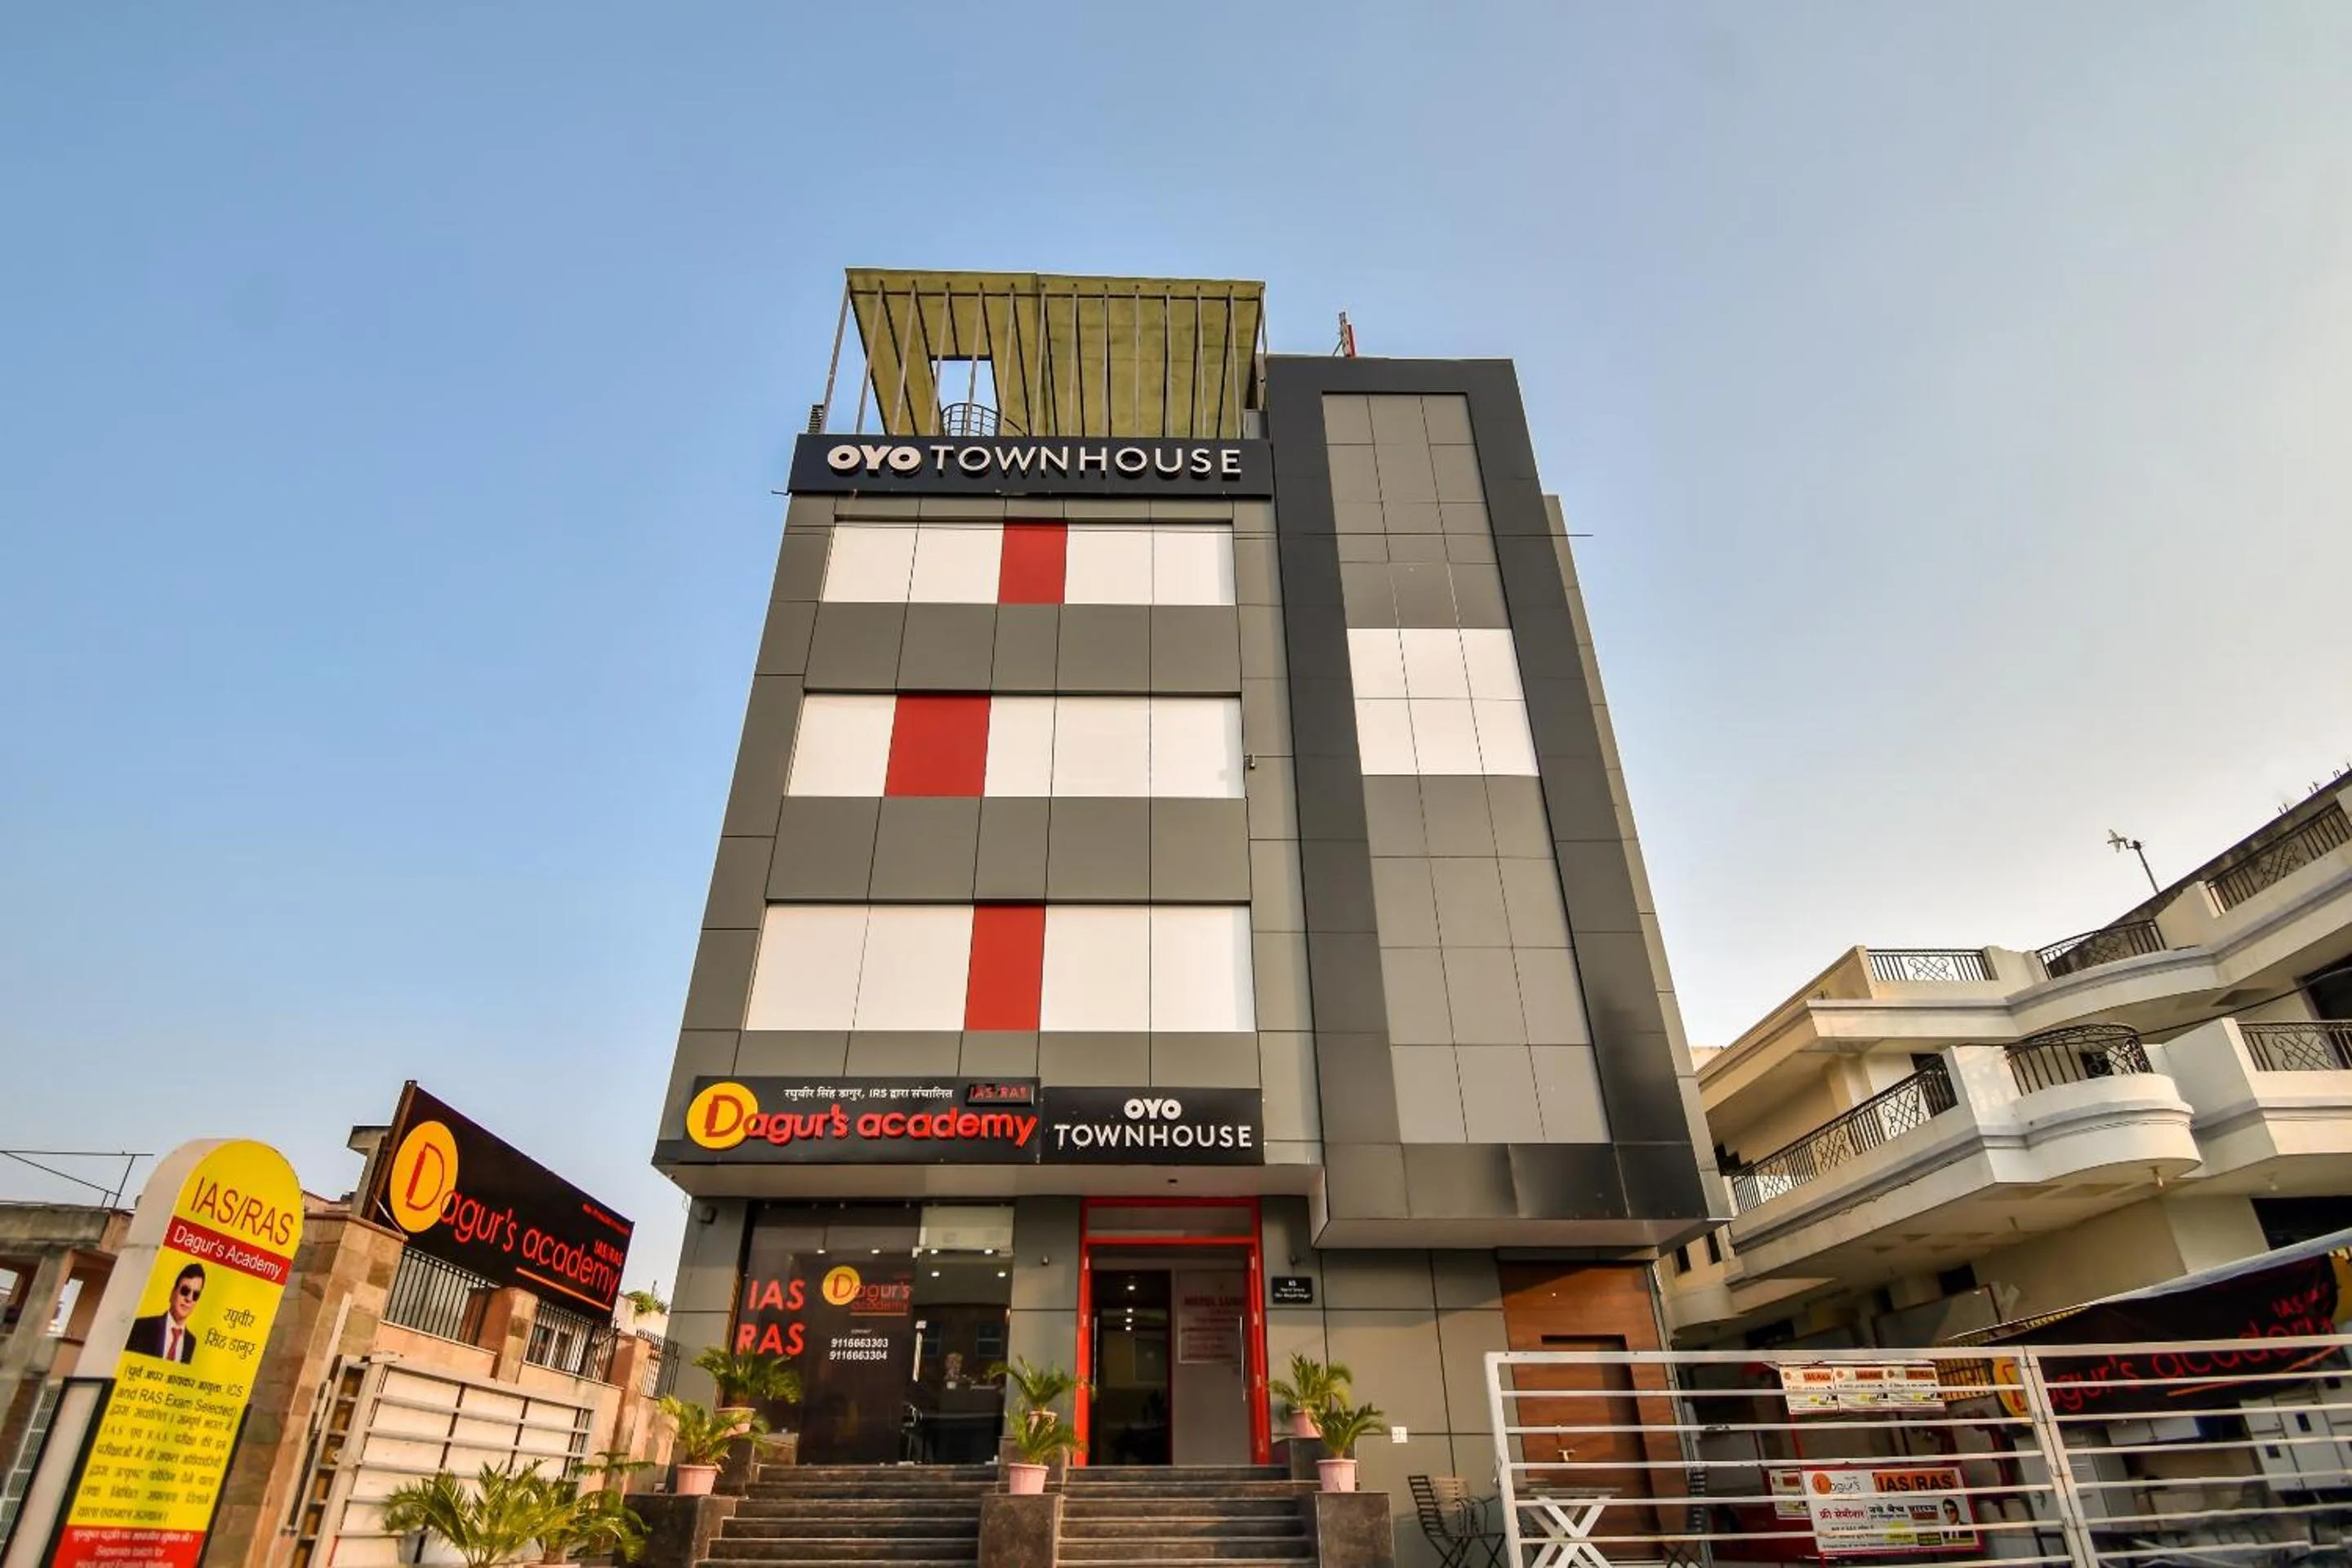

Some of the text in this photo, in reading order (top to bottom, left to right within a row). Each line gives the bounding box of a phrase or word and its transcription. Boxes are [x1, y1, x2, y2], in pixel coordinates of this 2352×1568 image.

[827, 444, 1241, 475] OYO TOWNHOUSE
[869, 1089, 887, 1099] IRS
[1124, 1098, 1182, 1120] OYO
[705, 1094, 1037, 1148] Dagur's academy
[1054, 1124, 1253, 1148] TOWNHOUSE
[189, 1176, 295, 1245] IAS/RAS
[405, 1141, 621, 1305] Dagur's academy
[173, 1224, 283, 1281] Dagur's Academy
[747, 1279, 806, 1311] IAS
[737, 1322, 806, 1356] RAS
[139, 1388, 163, 1405] RAS
